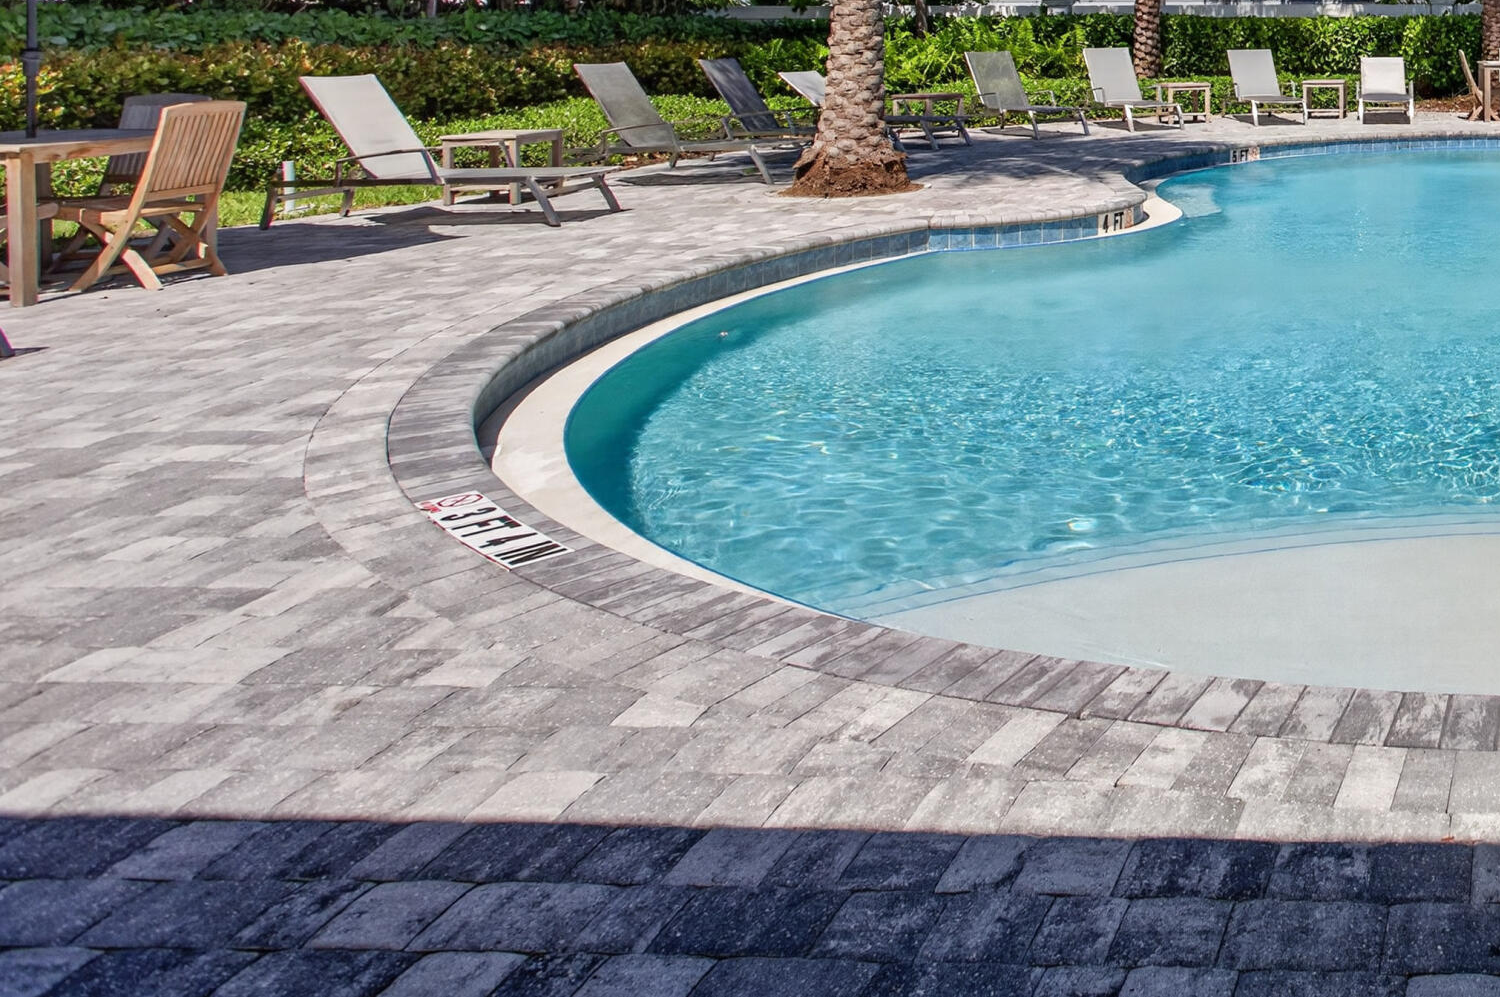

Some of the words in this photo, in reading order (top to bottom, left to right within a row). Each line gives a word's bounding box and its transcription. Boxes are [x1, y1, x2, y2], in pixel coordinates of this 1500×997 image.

[1232, 150, 1237, 162] 5
[1240, 148, 1249, 161] FT
[1103, 214, 1109, 233] 4
[1113, 211, 1124, 231] FT
[440, 507, 497, 521] 3
[451, 515, 522, 537] FT
[479, 532, 538, 548] 4
[494, 540, 567, 565] IN
